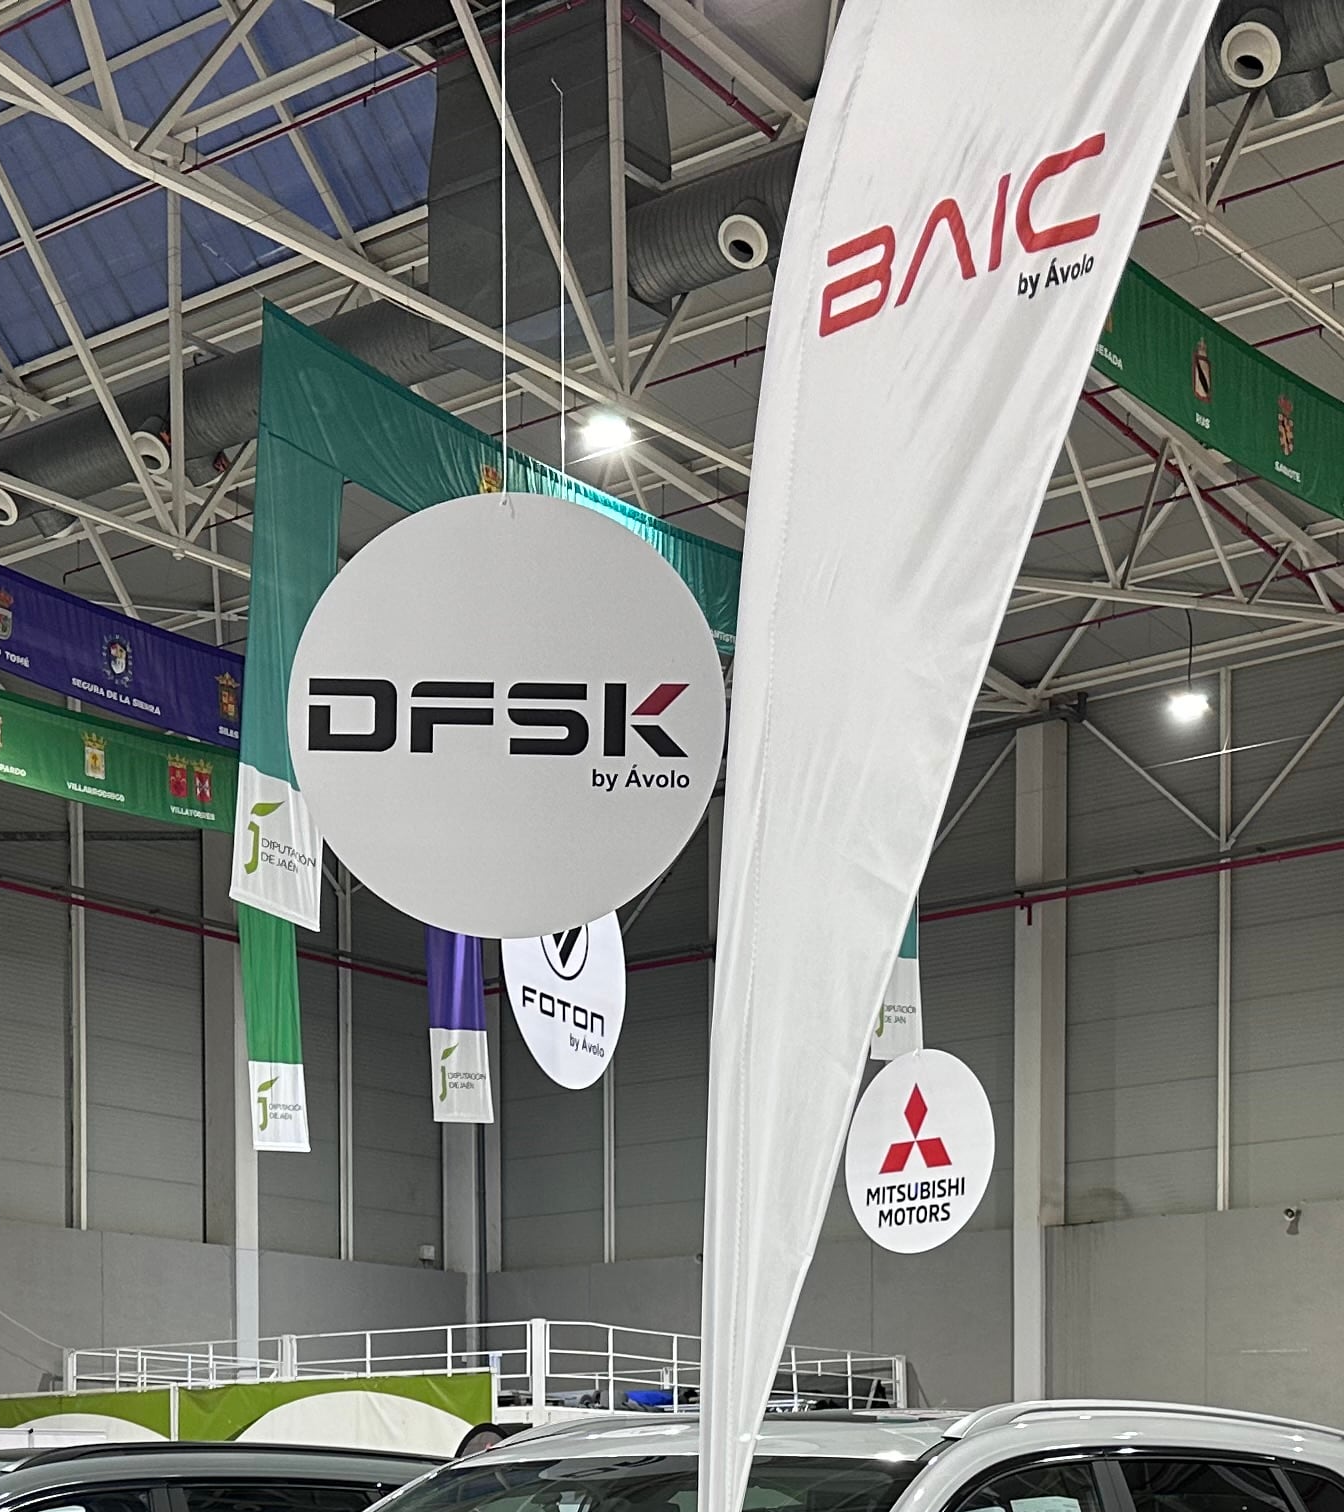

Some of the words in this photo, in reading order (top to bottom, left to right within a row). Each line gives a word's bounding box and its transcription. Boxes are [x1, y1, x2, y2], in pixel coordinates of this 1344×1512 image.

[818, 131, 1106, 338] BAIC
[1016, 271, 1041, 300] by
[1044, 253, 1095, 288] Ávolo
[4, 649, 30, 668] TOMÉ
[307, 678, 690, 758] DFSK
[591, 768, 619, 791] by
[624, 764, 690, 789] Ávolo
[260, 851, 276, 865] DE
[522, 984, 605, 1038] FOTON
[569, 1032, 581, 1052] by
[866, 1176, 965, 1207] MITSUBISHI
[878, 1201, 951, 1229] MOTORS
